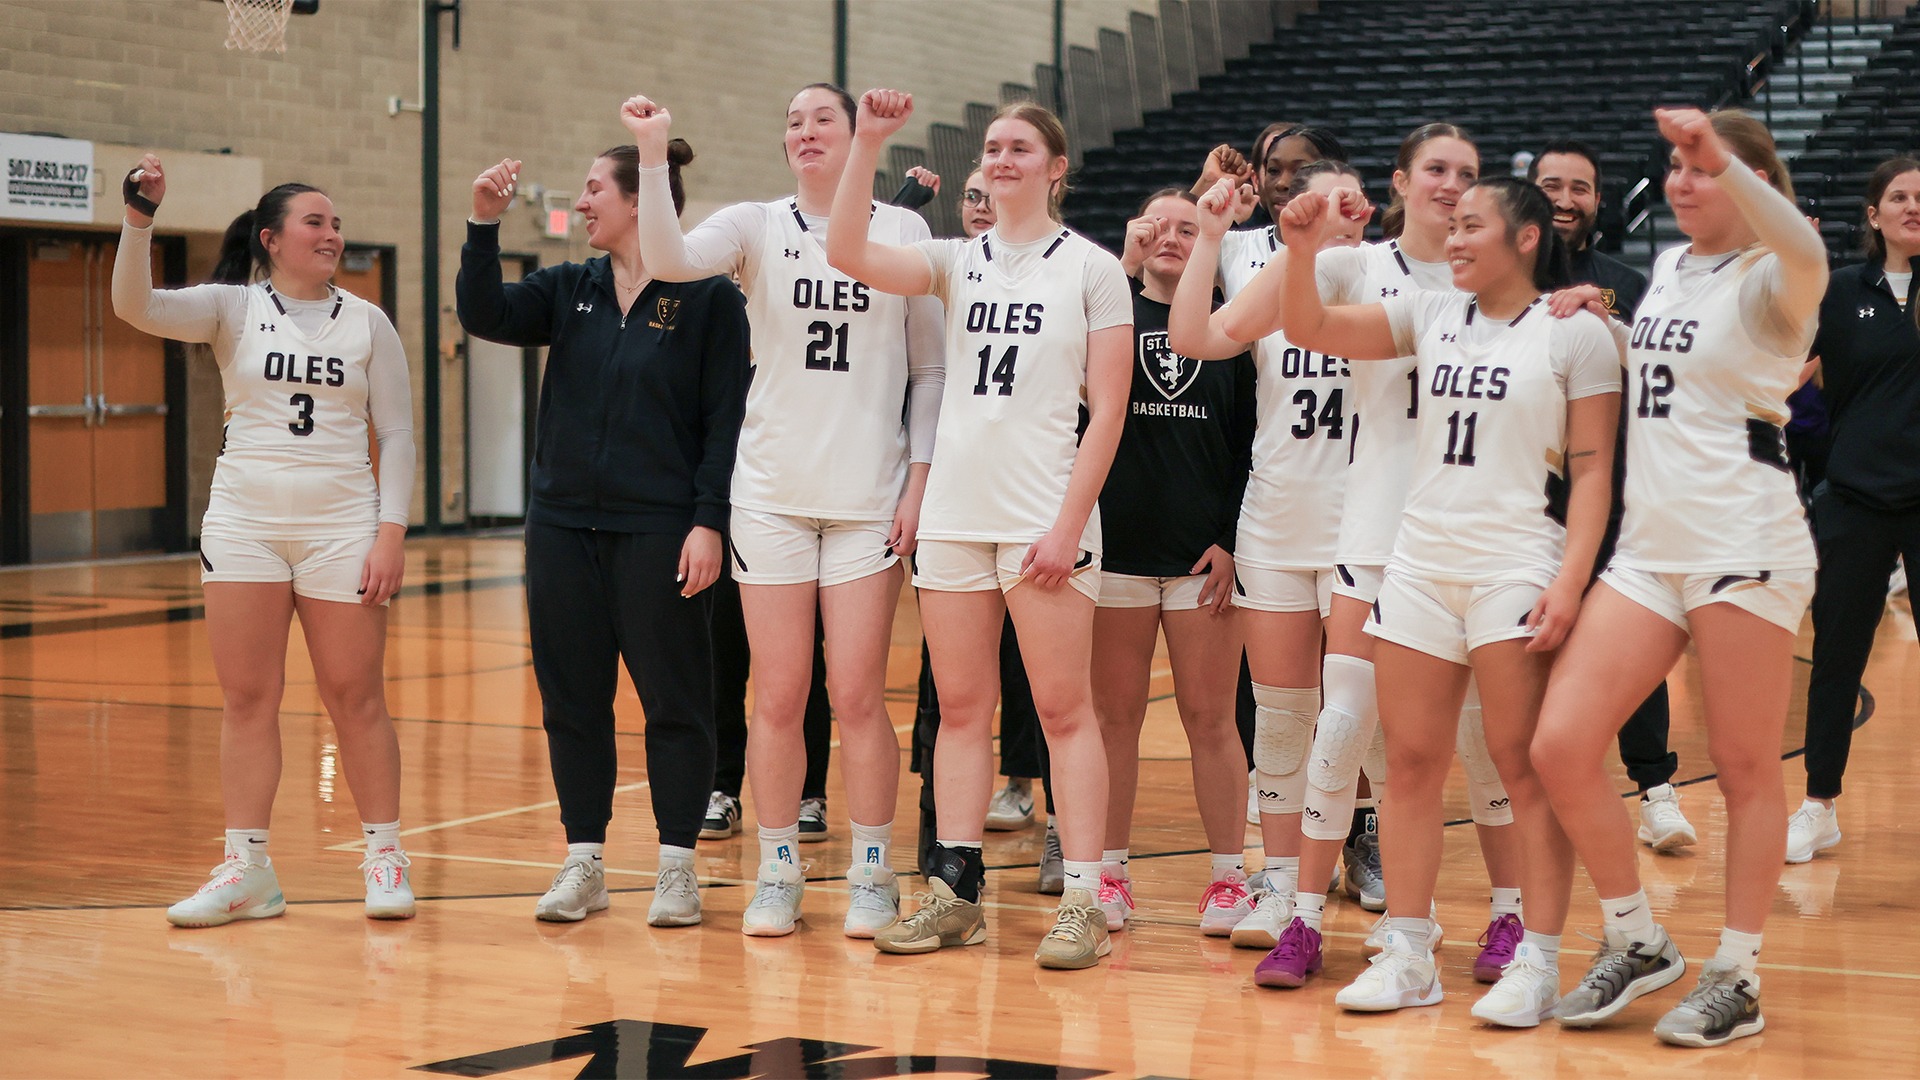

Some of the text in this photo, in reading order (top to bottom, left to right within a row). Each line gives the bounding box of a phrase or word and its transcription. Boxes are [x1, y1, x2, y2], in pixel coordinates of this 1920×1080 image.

[793, 278, 870, 313] OLES
[966, 302, 1044, 335] OLES
[1631, 316, 1699, 353] OLES
[805, 321, 850, 373] 21
[1146, 337, 1163, 350] ST.
[264, 352, 345, 387] OLES
[973, 345, 1019, 396] 14
[1431, 364, 1511, 401] OLES
[1637, 363, 1676, 419] 12
[288, 393, 314, 436] 3
[1133, 402, 1208, 419] BASKETBALL
[1291, 389, 1343, 440] 34
[1443, 410, 1478, 467] 11
